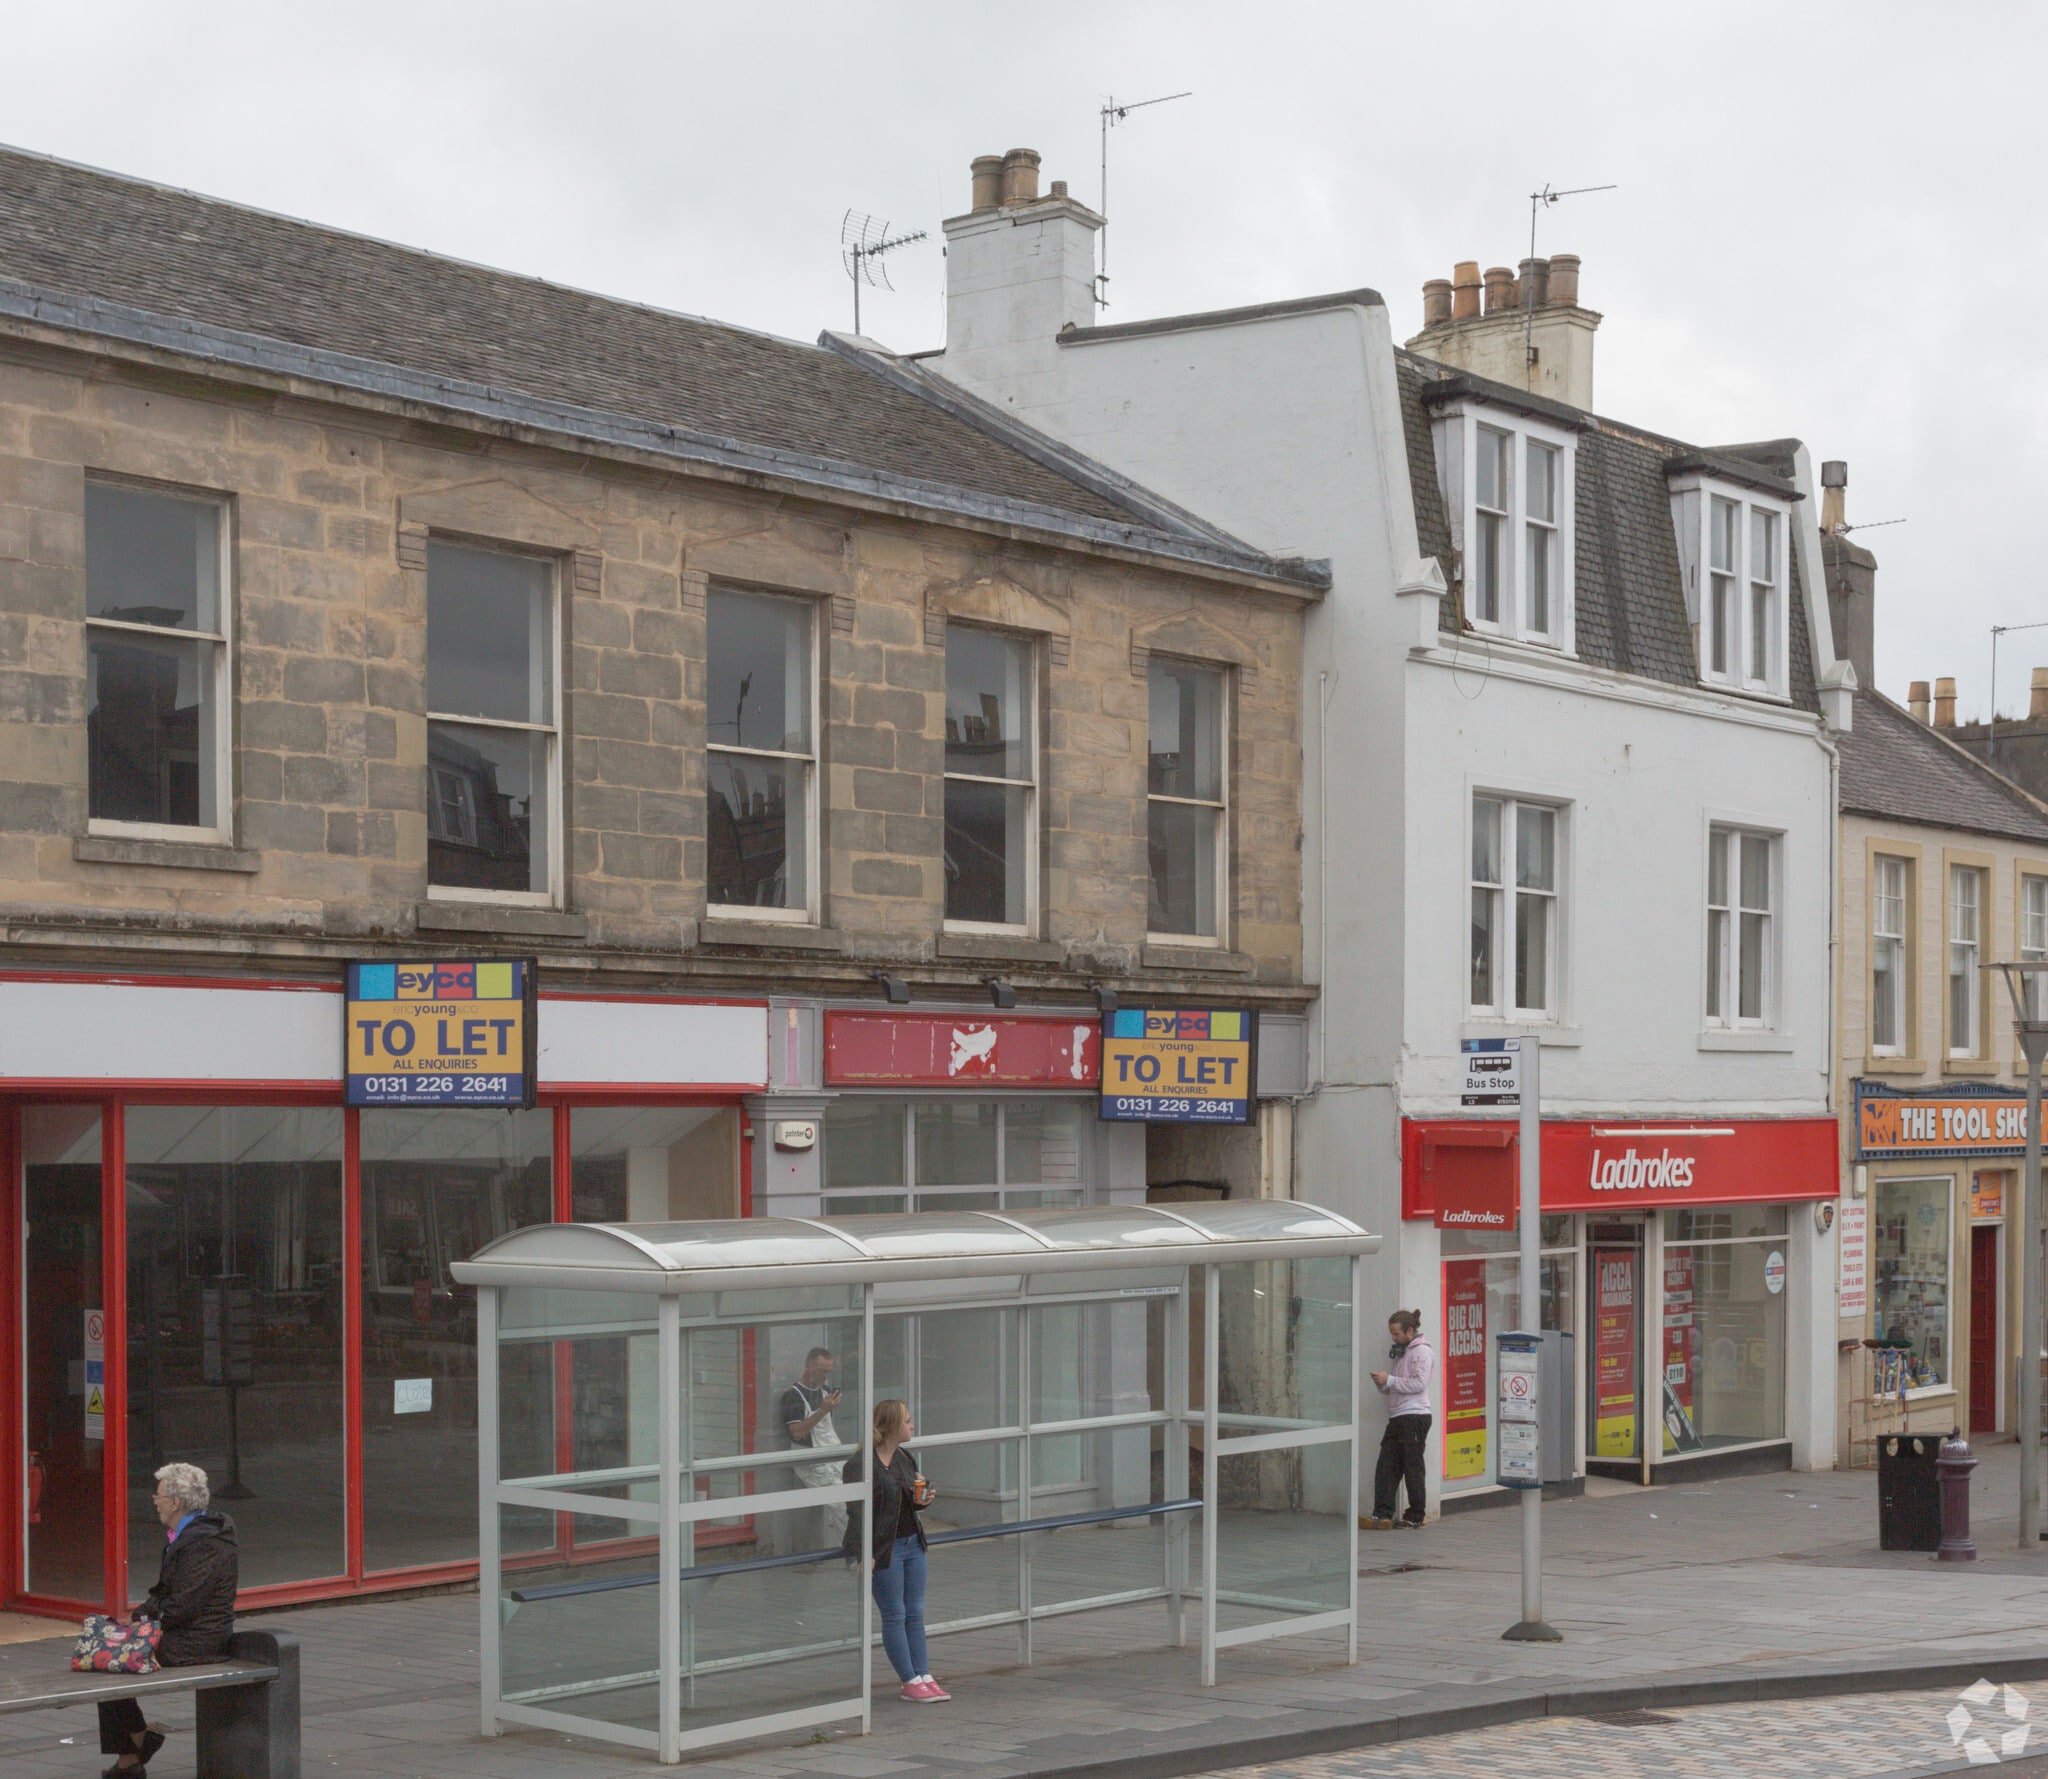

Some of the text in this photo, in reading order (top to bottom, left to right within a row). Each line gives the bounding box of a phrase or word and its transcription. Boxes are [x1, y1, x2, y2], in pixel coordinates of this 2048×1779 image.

[397, 972, 475, 993] eyco
[1145, 1016, 1210, 1034] eyco
[356, 1019, 515, 1057] TO LET
[393, 1059, 478, 1070] ALL ENQUIRIES
[1113, 1054, 1239, 1084] TO LET
[365, 1077, 507, 1092] 0131 226 2641
[1142, 1085, 1208, 1095] ALL ENQUIRIES
[1466, 1077, 1515, 1090] Bus Stop
[1116, 1098, 1234, 1114] 0131 226 2641
[1900, 1106, 1937, 1140] THE
[1942, 1106, 1992, 1140] TOOL
[1590, 1148, 1696, 1190] Ladbrokes
[1442, 1209, 1505, 1224] Ladbrokes
[1602, 1261, 1632, 1292] ACCA
[1448, 1304, 1482, 1330] BIG ON
[1448, 1329, 1483, 1357] ACCAs
